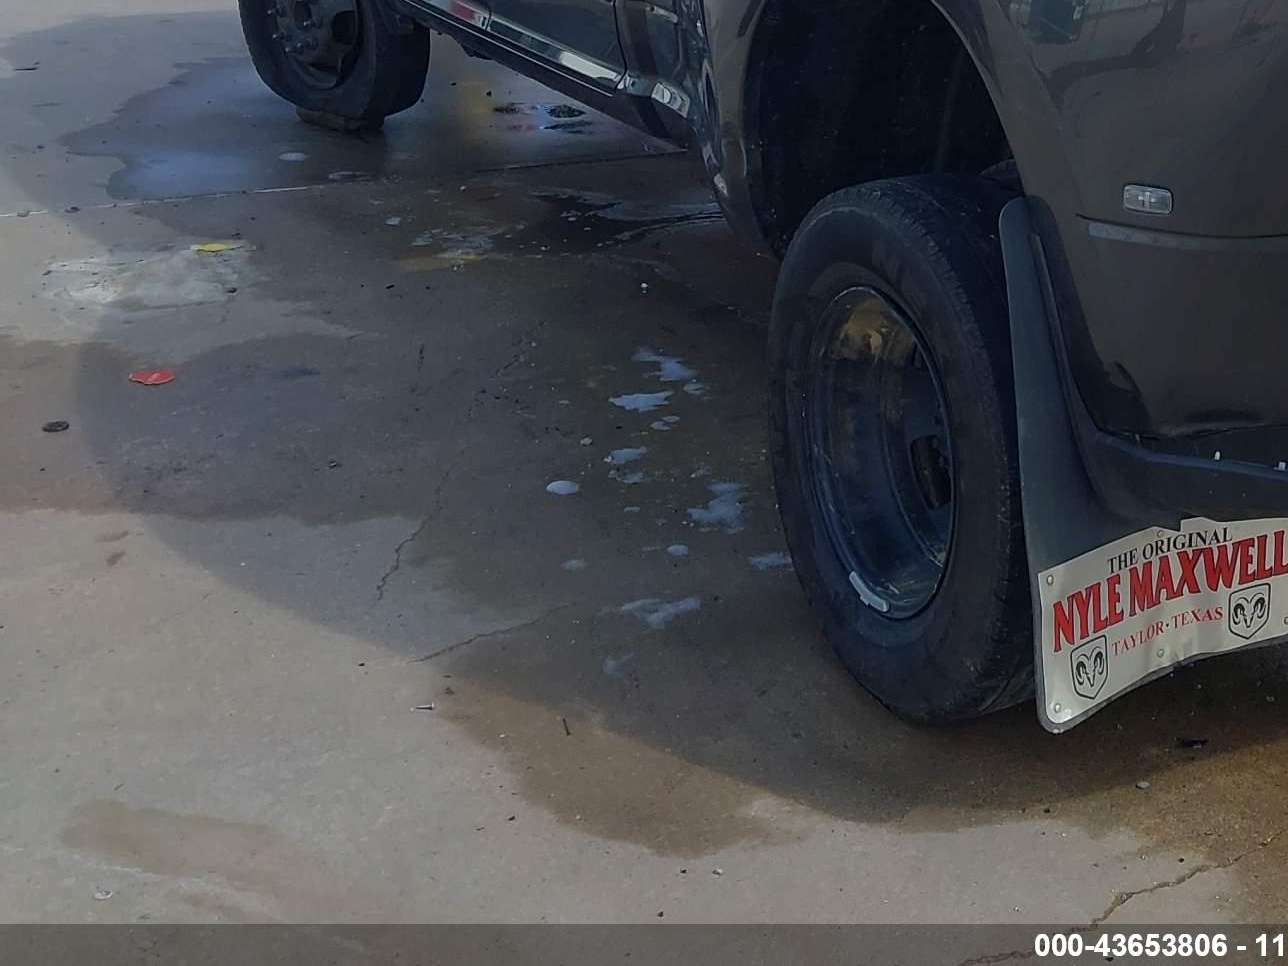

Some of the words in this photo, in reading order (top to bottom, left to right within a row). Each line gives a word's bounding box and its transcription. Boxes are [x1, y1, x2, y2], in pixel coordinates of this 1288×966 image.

[1107, 548, 1139, 575] THE
[1142, 527, 1233, 560] ORIGINAL
[1053, 574, 1125, 652] NYLE
